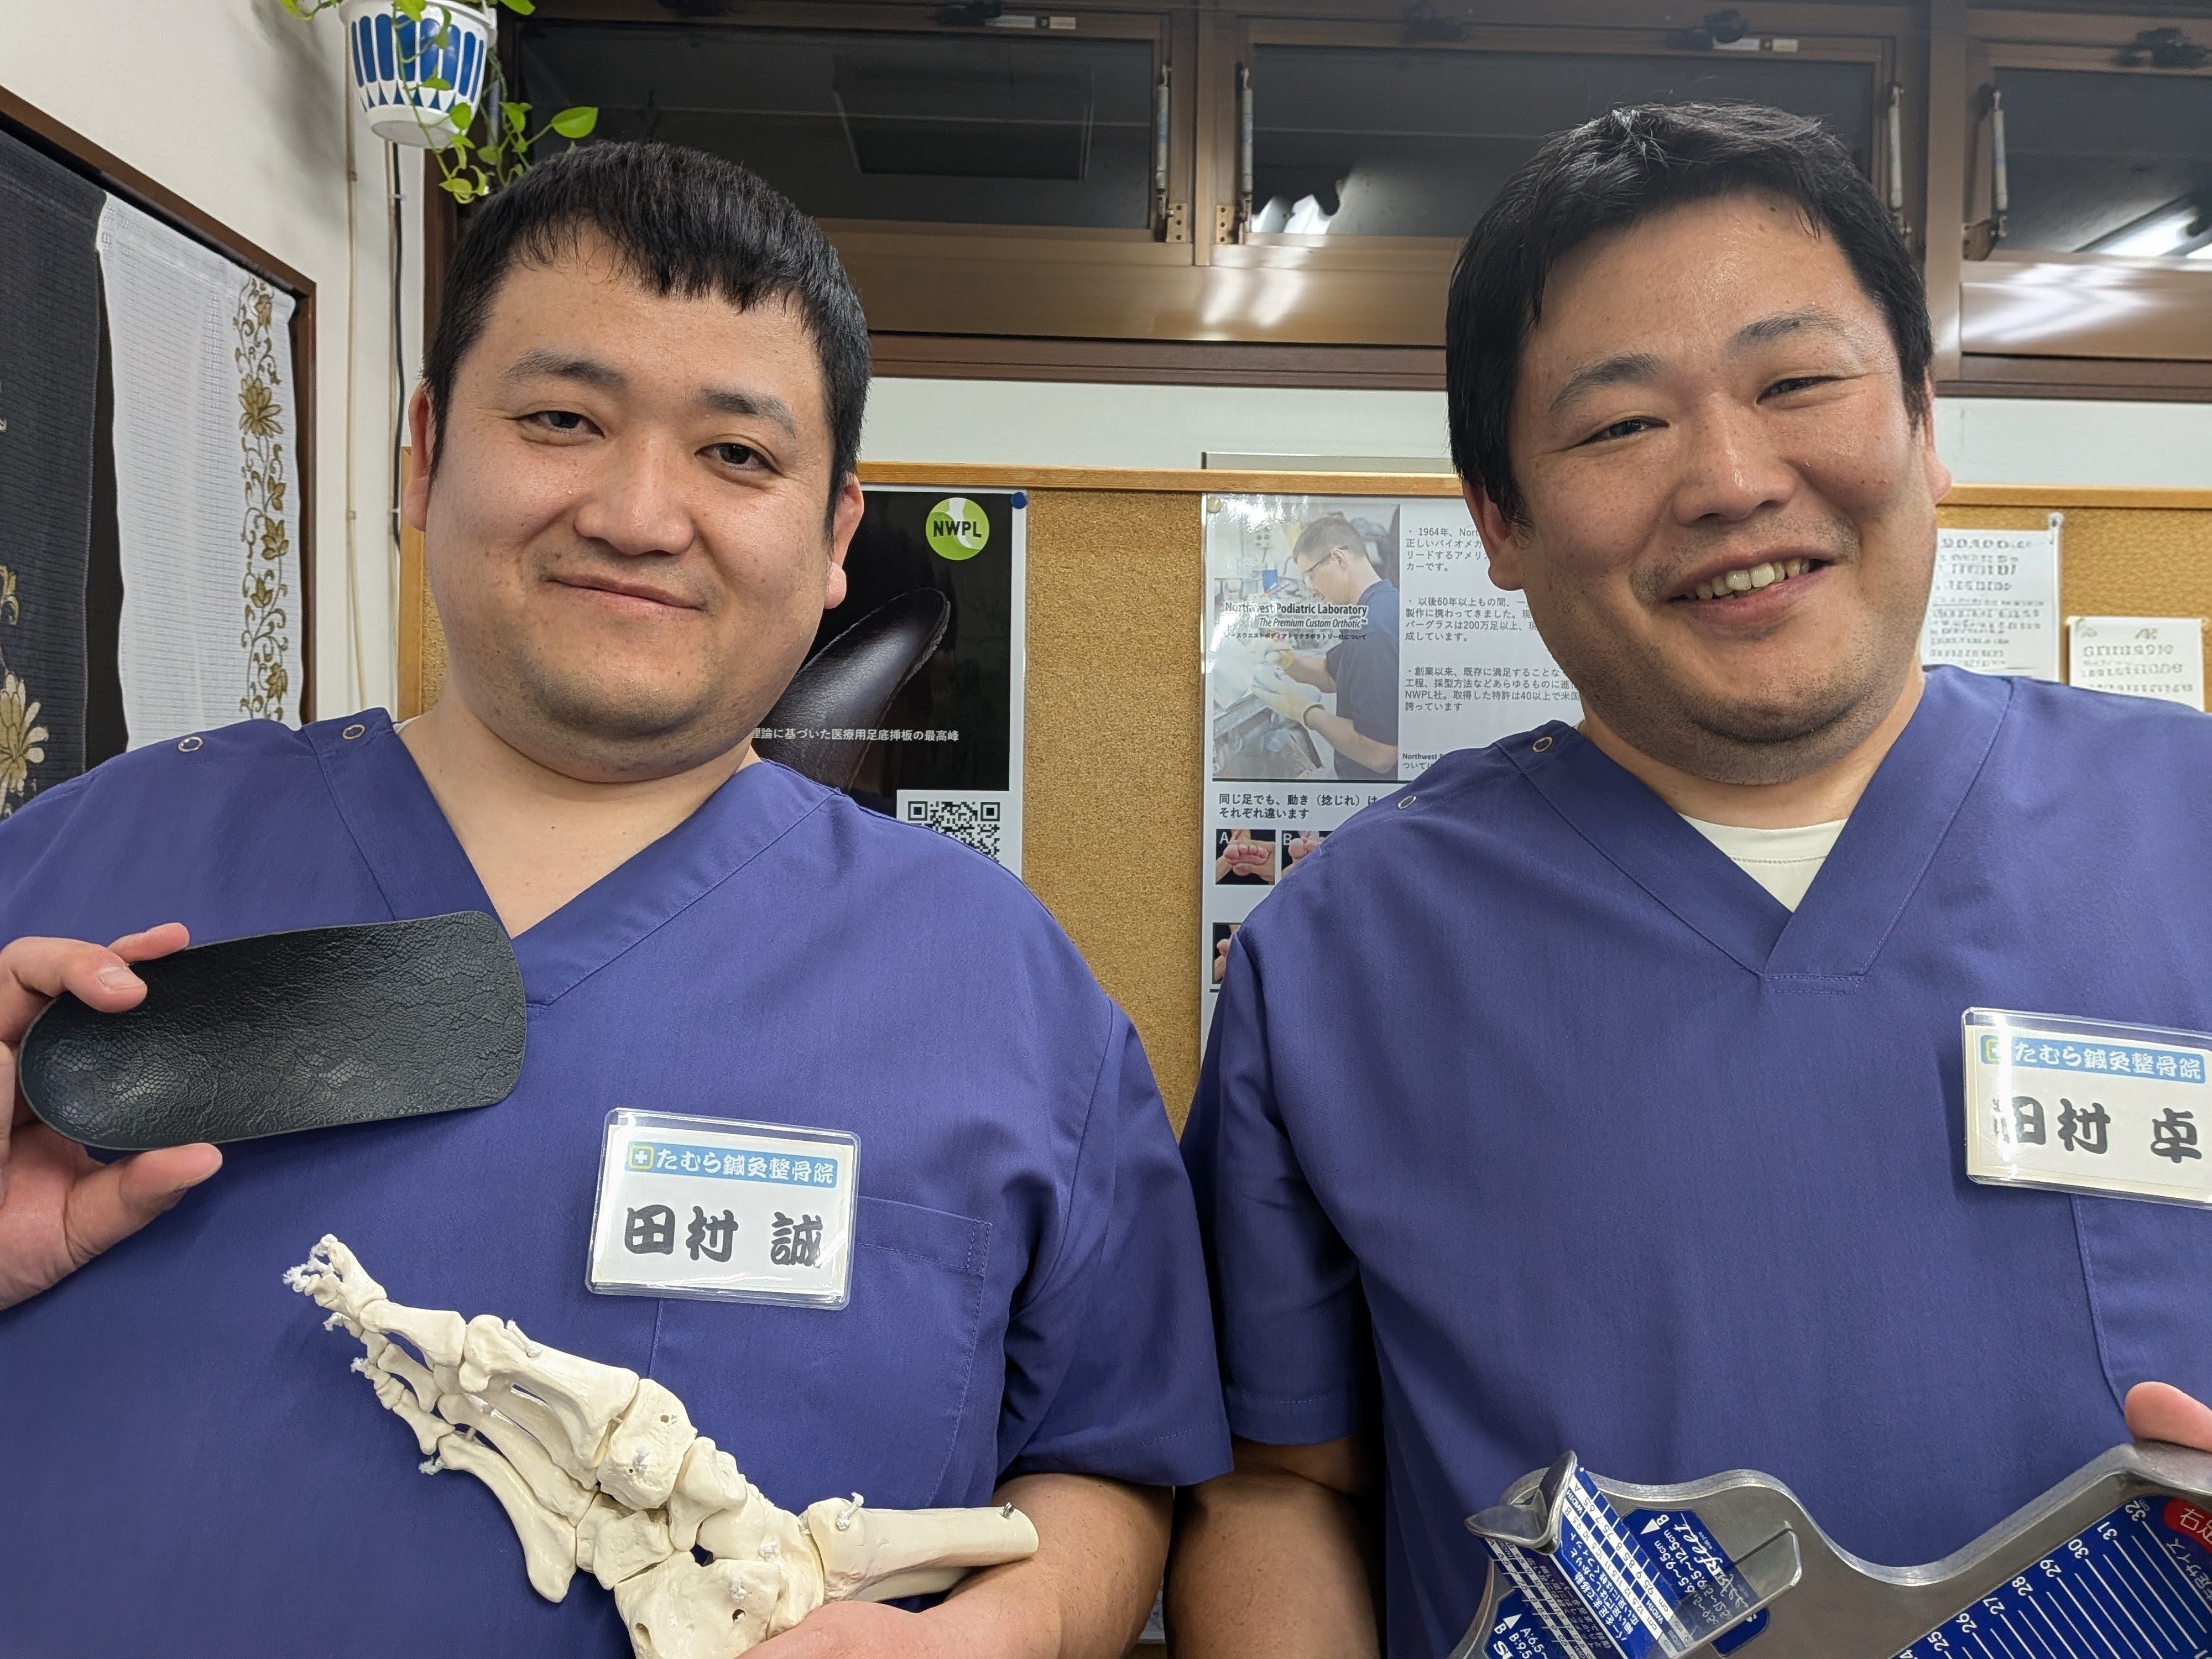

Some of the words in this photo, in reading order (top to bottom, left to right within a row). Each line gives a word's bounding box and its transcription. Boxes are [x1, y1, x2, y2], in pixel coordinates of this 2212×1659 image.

[932, 520, 982, 539] NWPL
[1406, 562, 1448, 572] カーです。
[1276, 603, 1316, 614] Podiatric
[1317, 604, 1367, 617] Laboratory
[1259, 618, 1271, 627] The
[1273, 618, 1303, 628] Premium
[1306, 618, 1331, 628] Custom
[1405, 632, 1467, 642] 成しています。
[1405, 702, 1463, 712] 誇っています
[1219, 807, 1310, 820] それぞれ違います
[1219, 833, 1229, 844] A
[1283, 833, 1292, 846] B
[2015, 1041, 2201, 1080] たむら鍼灸整骨院
[656, 1149, 834, 1185] たむら鍼灸整骨院
[624, 1204, 739, 1262] 田村
[770, 1212, 823, 1267] 誠
[1657, 1514, 1670, 1526] B
[2125, 1500, 2146, 1521] 32
[2096, 1521, 2117, 1540] 31
[1565, 1490, 1584, 1512] WIDTH
[1645, 1600, 1665, 1623] WIDTH
[1572, 1483, 1580, 1491] A
[1582, 1498, 1595, 1512] 6.5
[1622, 1552, 1636, 1567] 8.5
[1657, 1599, 1668, 1611] cm
[2068, 1539, 2089, 1559] 30
[2039, 1559, 2062, 1577] 29
[1567, 1548, 1634, 1633] 細い足にはしっかりと
[2011, 1576, 2033, 1596] 28
[1573, 1572, 1629, 1642] バーを足まで移動
[1983, 1597, 2005, 1614] 27
[1494, 1623, 1507, 1635] B
[1646, 1617, 1657, 1630] cm
[1955, 1613, 1977, 1633] 26
[1927, 1631, 1949, 1651] 25
